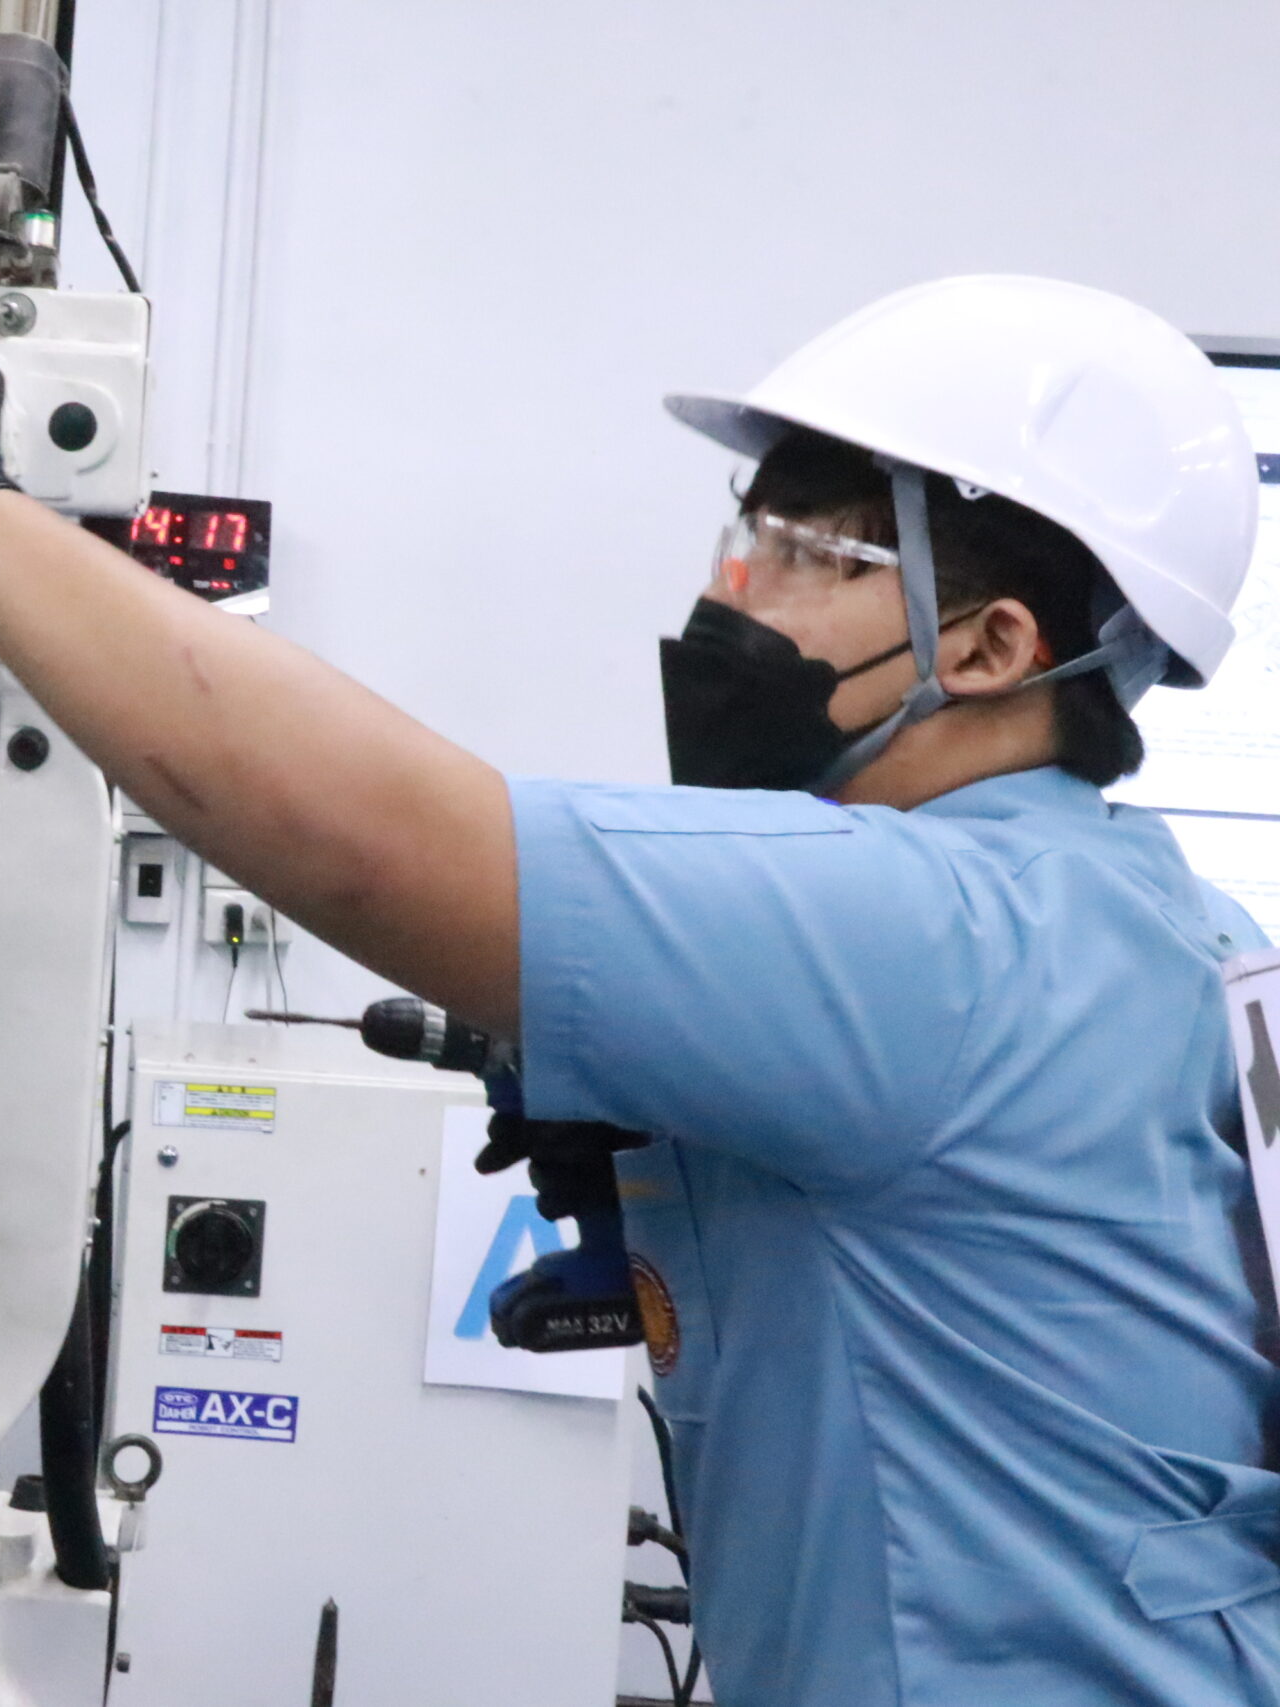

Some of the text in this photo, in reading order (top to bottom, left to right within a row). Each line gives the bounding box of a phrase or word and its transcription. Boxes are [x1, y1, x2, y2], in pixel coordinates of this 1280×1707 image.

[130, 506, 248, 552] 14:17
[588, 1313, 629, 1335] 32V
[163, 1393, 194, 1404] OTC
[158, 1404, 197, 1420] DAIHEN
[199, 1392, 292, 1428] AX-C
